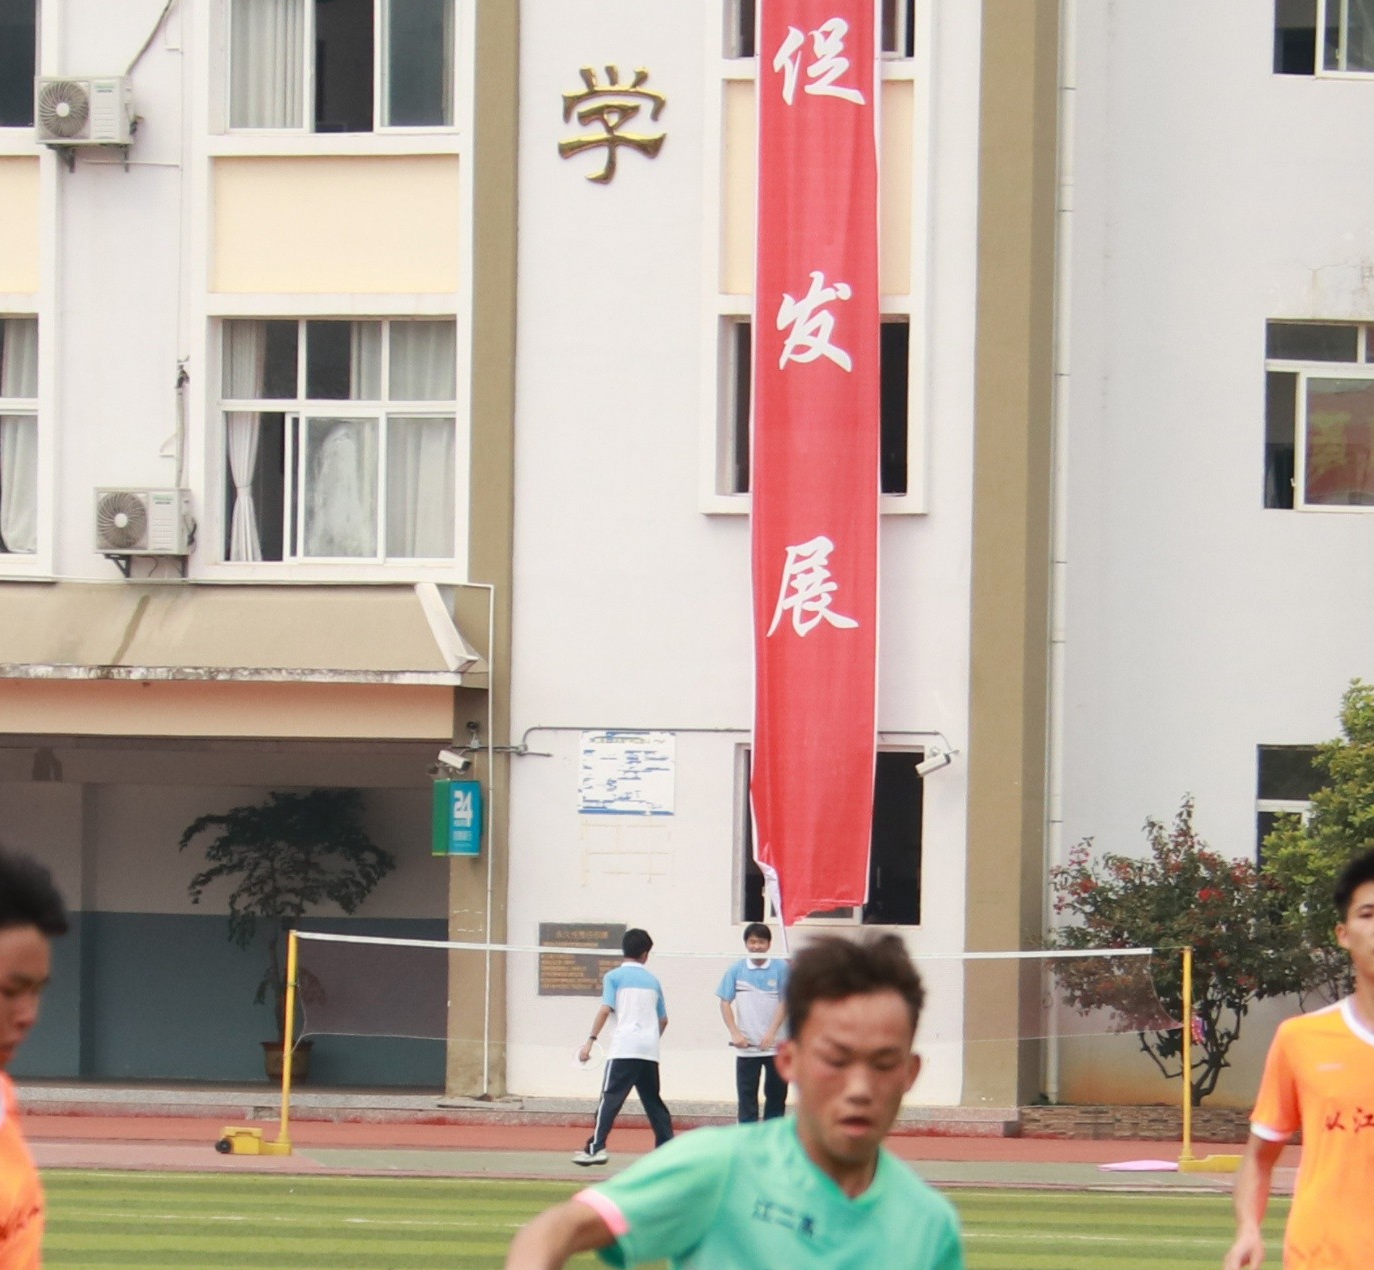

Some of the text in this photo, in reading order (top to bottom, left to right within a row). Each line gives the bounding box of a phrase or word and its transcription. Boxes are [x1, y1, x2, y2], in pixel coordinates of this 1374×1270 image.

[557, 64, 668, 185] 学
[766, 16, 866, 639] 促发展
